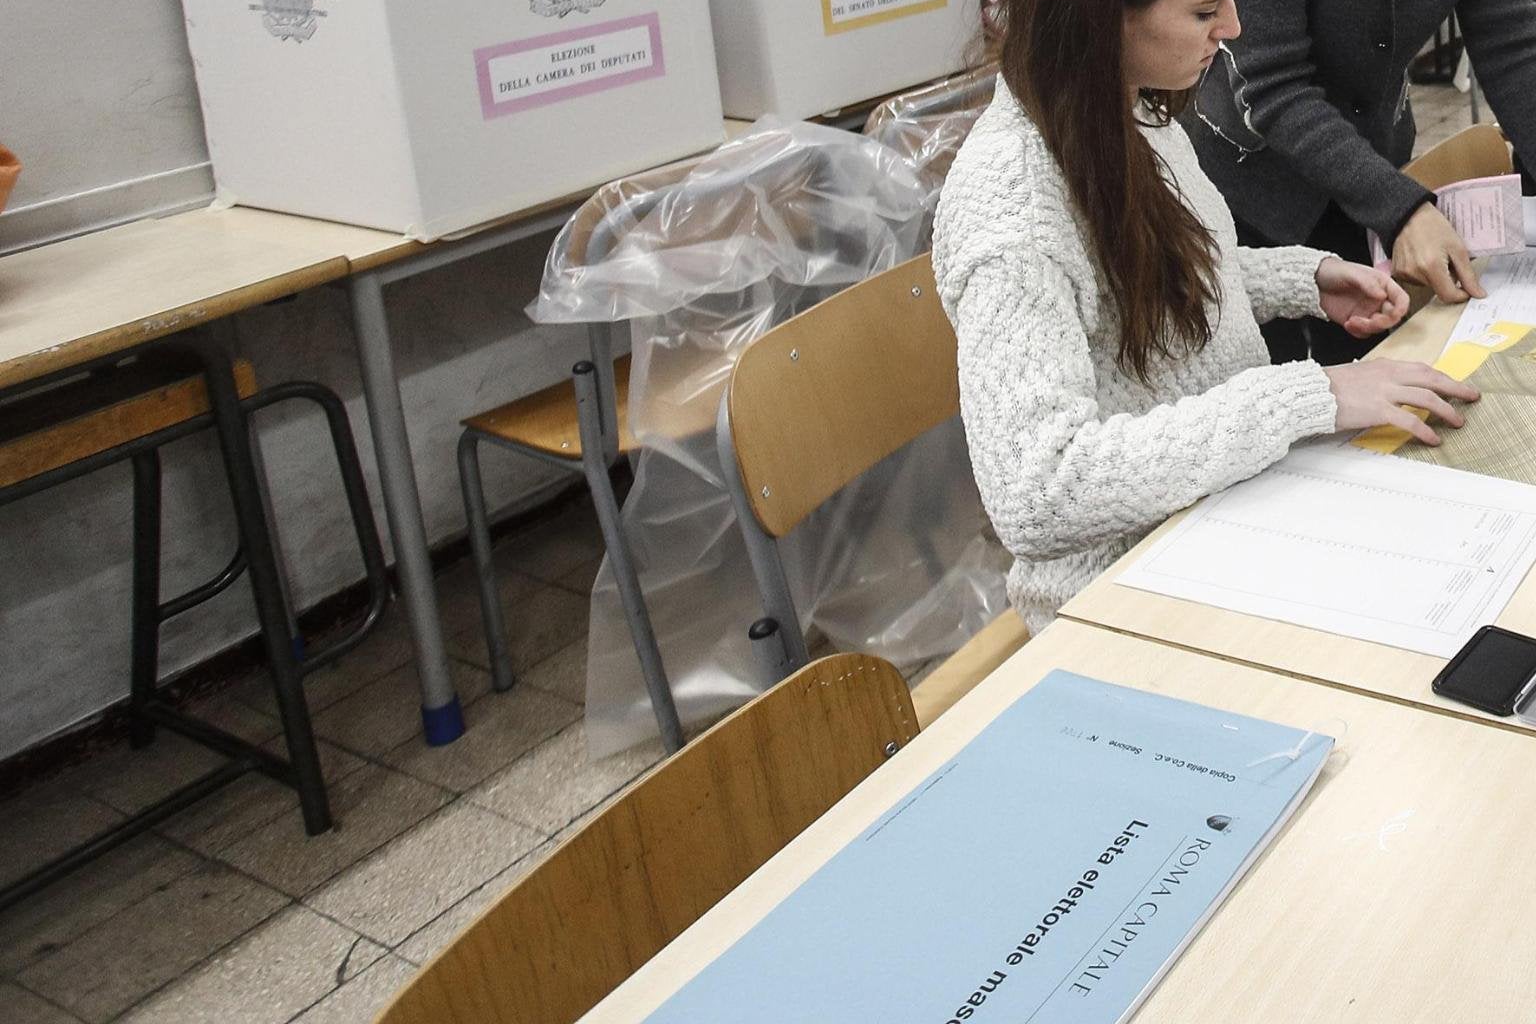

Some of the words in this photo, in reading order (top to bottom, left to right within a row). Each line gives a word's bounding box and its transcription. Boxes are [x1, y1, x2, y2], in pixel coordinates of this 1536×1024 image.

[500, 78, 531, 93] DELLA
[536, 67, 575, 84] CAMERA
[580, 62, 597, 74] DEI
[601, 50, 646, 69] DEPUTATI
[551, 44, 596, 64] ELEZIONE
[1108, 739, 1143, 755] Sezione
[1186, 762, 1208, 774] della
[1209, 769, 1236, 783] Copia
[1097, 819, 1149, 866] Lista
[1150, 837, 1211, 896] ROMA
[1006, 869, 1099, 966] elettorale
[1068, 902, 1158, 997] CAPITALE
